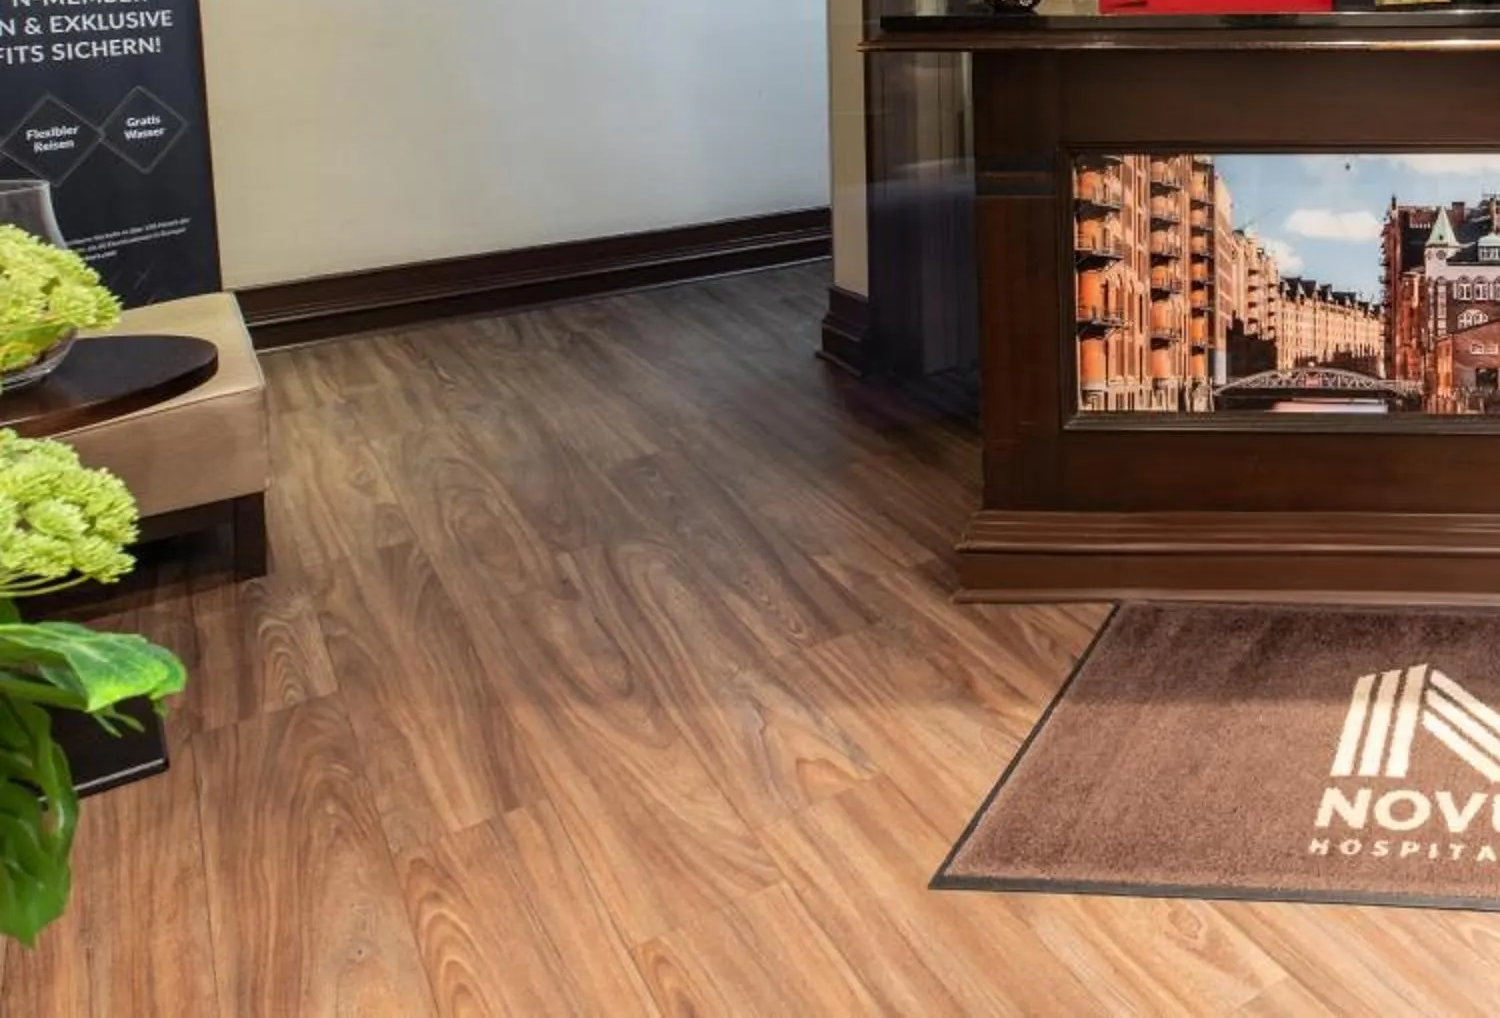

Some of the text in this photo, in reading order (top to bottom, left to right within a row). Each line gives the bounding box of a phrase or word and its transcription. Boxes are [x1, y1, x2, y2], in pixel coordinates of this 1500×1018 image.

[24, 17, 44, 35] &
[50, 9, 174, 33] EXKLUSIVE
[51, 36, 162, 62] SICHERN!
[126, 114, 161, 128] Gratis
[26, 125, 80, 141] Flexibler
